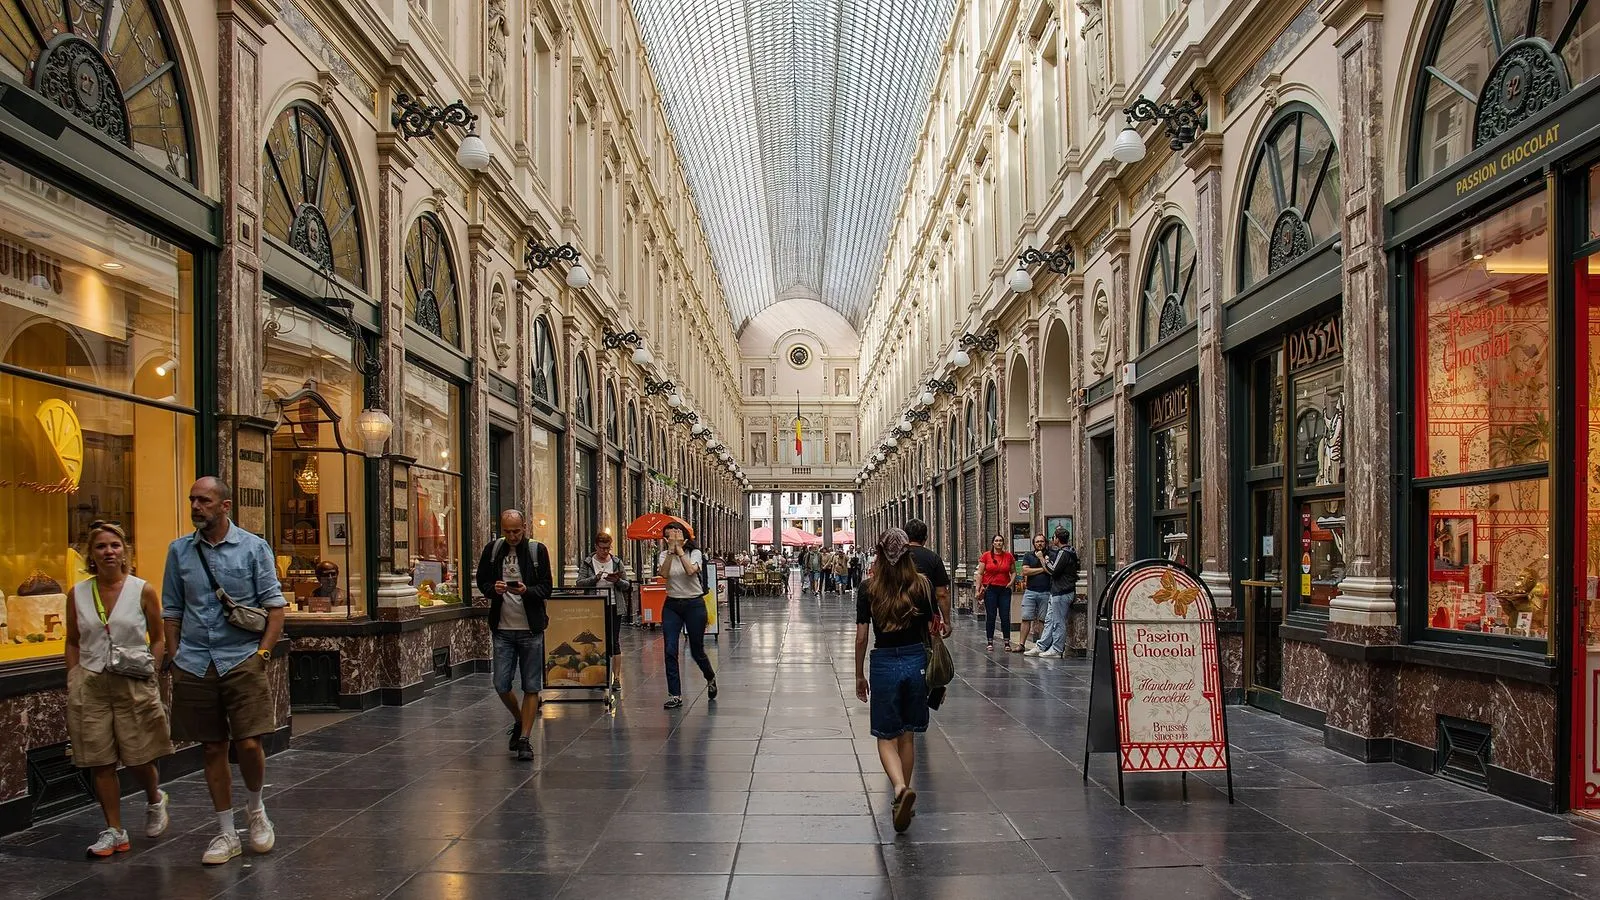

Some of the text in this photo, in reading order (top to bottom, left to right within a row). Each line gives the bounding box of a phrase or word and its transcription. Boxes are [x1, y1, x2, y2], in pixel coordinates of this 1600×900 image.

[1456, 124, 1560, 196] PASSION CHOCOLAT
[1448, 304, 1505, 337] Passion
[1443, 331, 1510, 374] Chocolat
[1150, 384, 1187, 427] TAVERNE
[1137, 628, 1189, 642] Passion
[1133, 643, 1196, 657] Chocolat
[1138, 678, 1195, 692] Handmade
[1142, 692, 1190, 703] chocolate
[1153, 721, 1188, 731] Brussels
[1154, 732, 1173, 740] since
